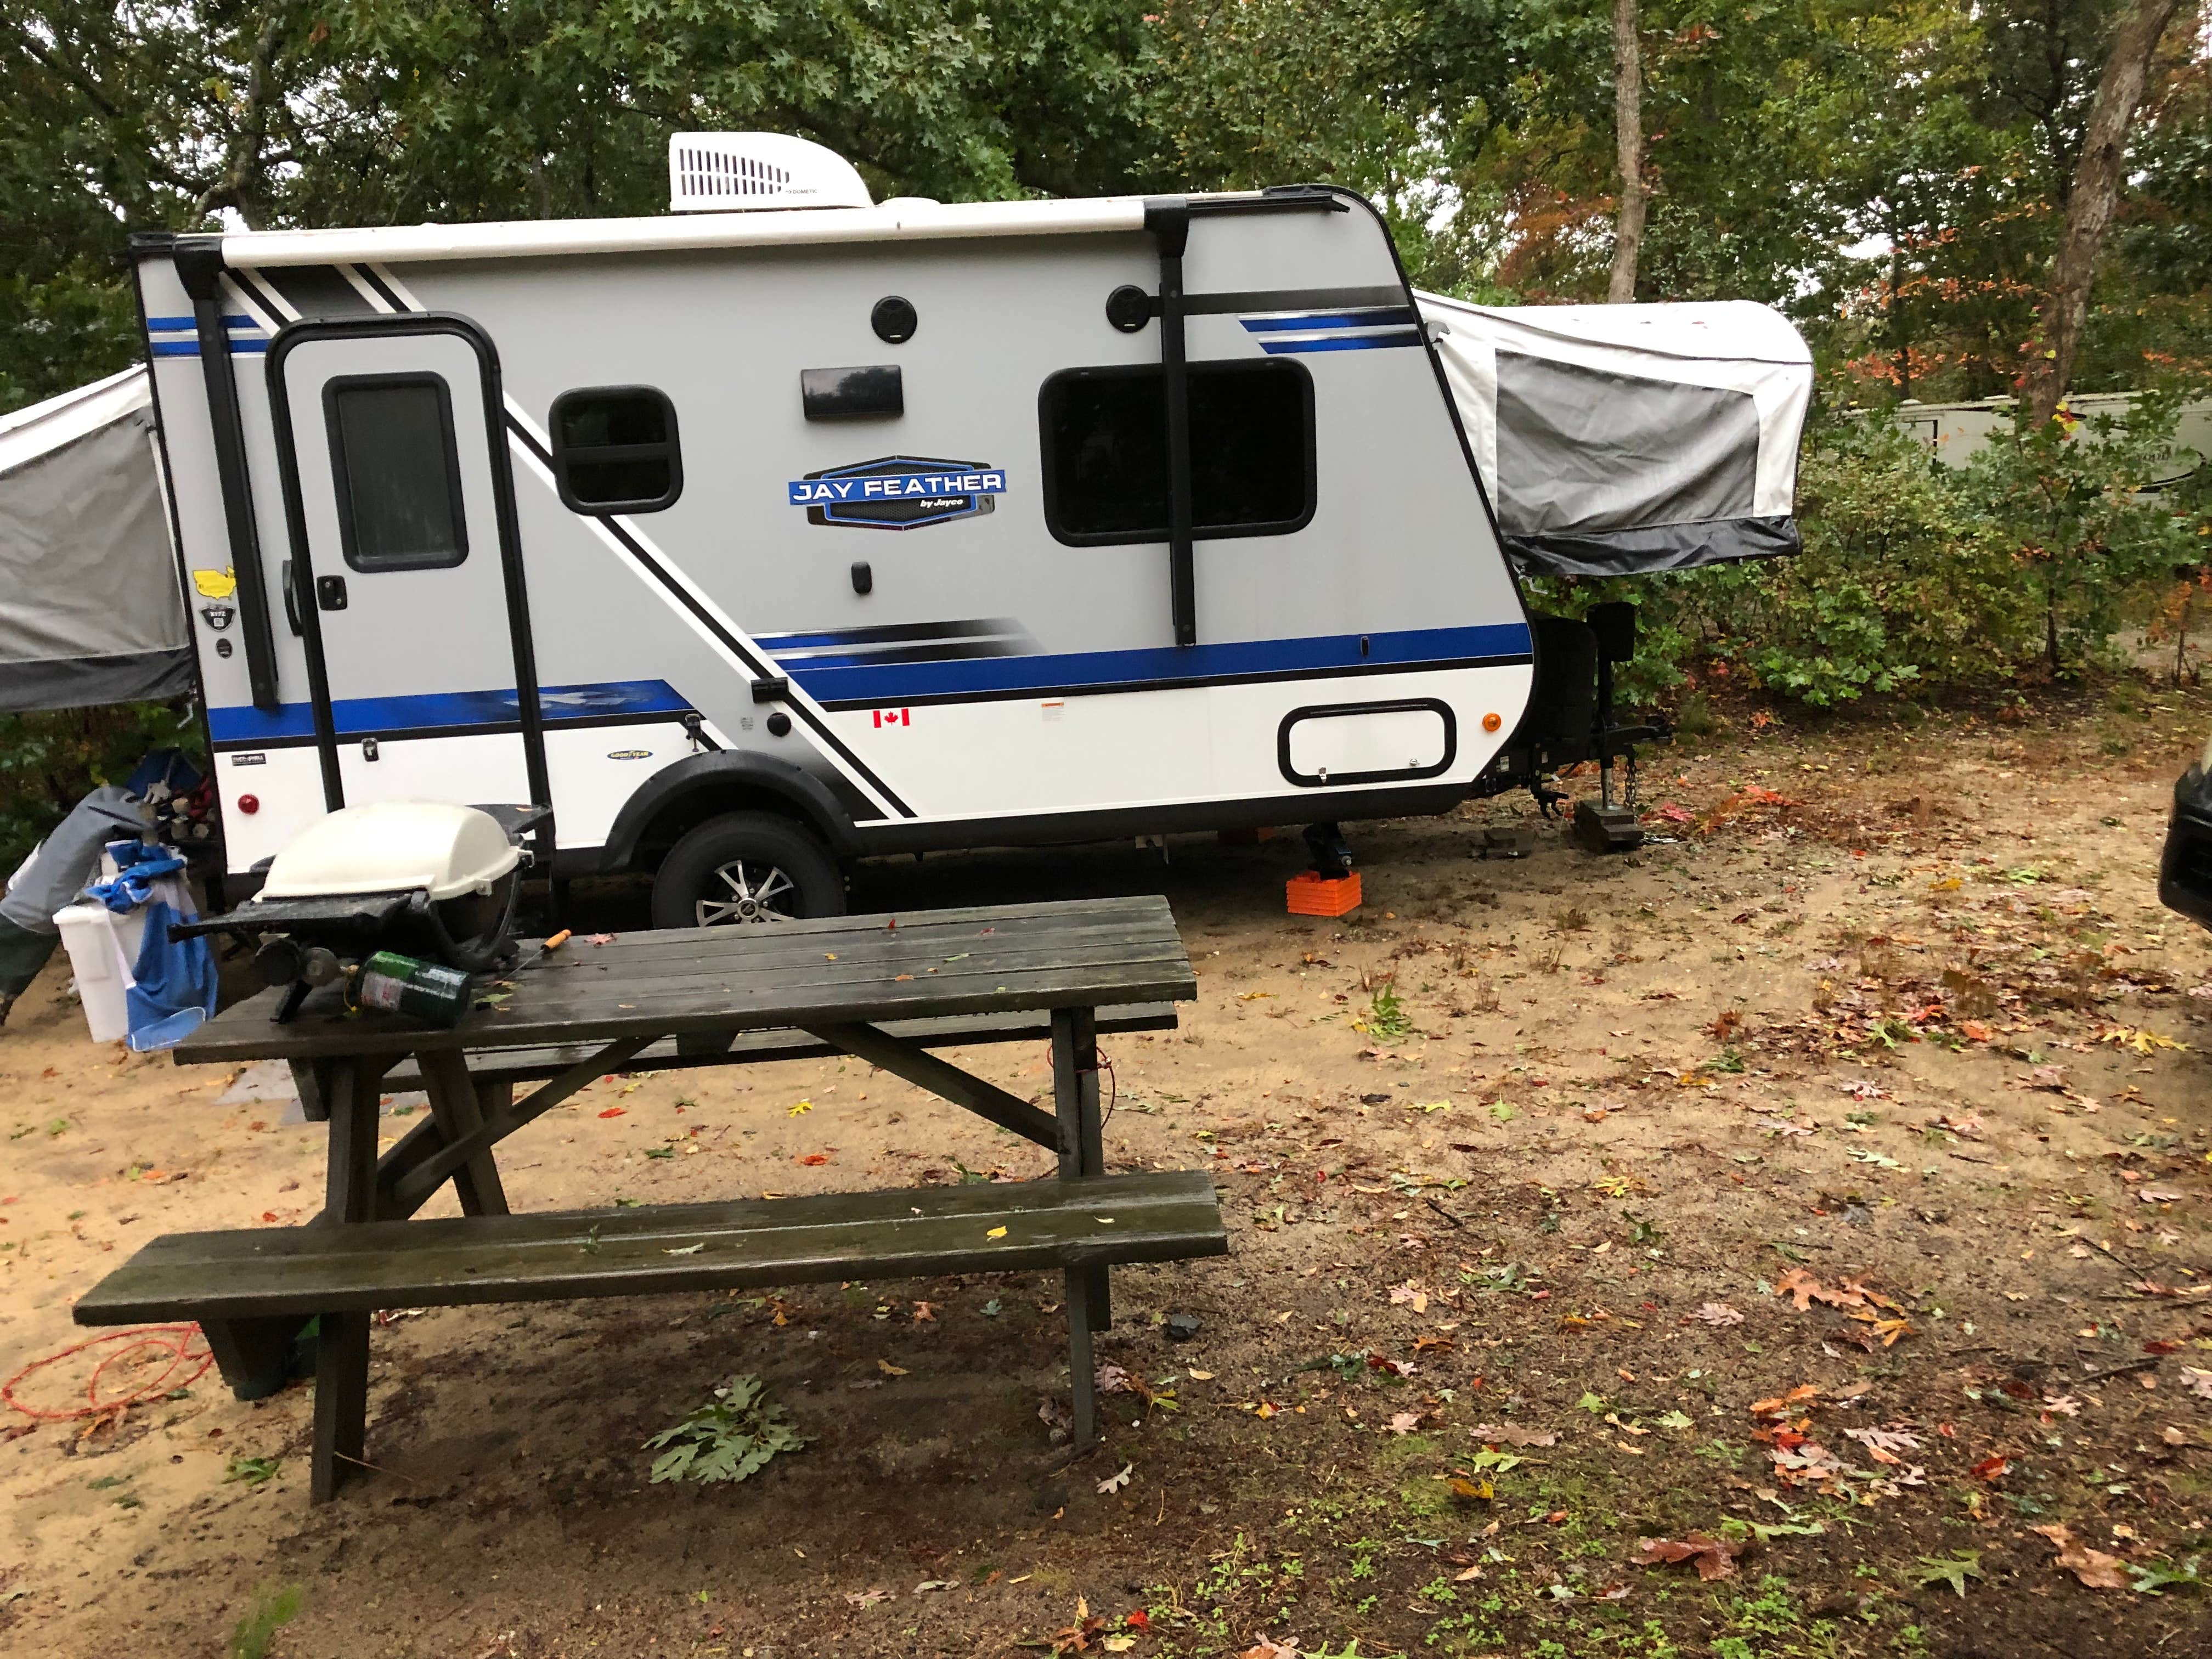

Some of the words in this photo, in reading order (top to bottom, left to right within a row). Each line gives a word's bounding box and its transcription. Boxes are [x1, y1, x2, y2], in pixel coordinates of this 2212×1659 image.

[793, 482, 854, 501] JAY
[864, 473, 1002, 497] FEATHER
[920, 500, 933, 508] by
[934, 499, 963, 507] Jayco
